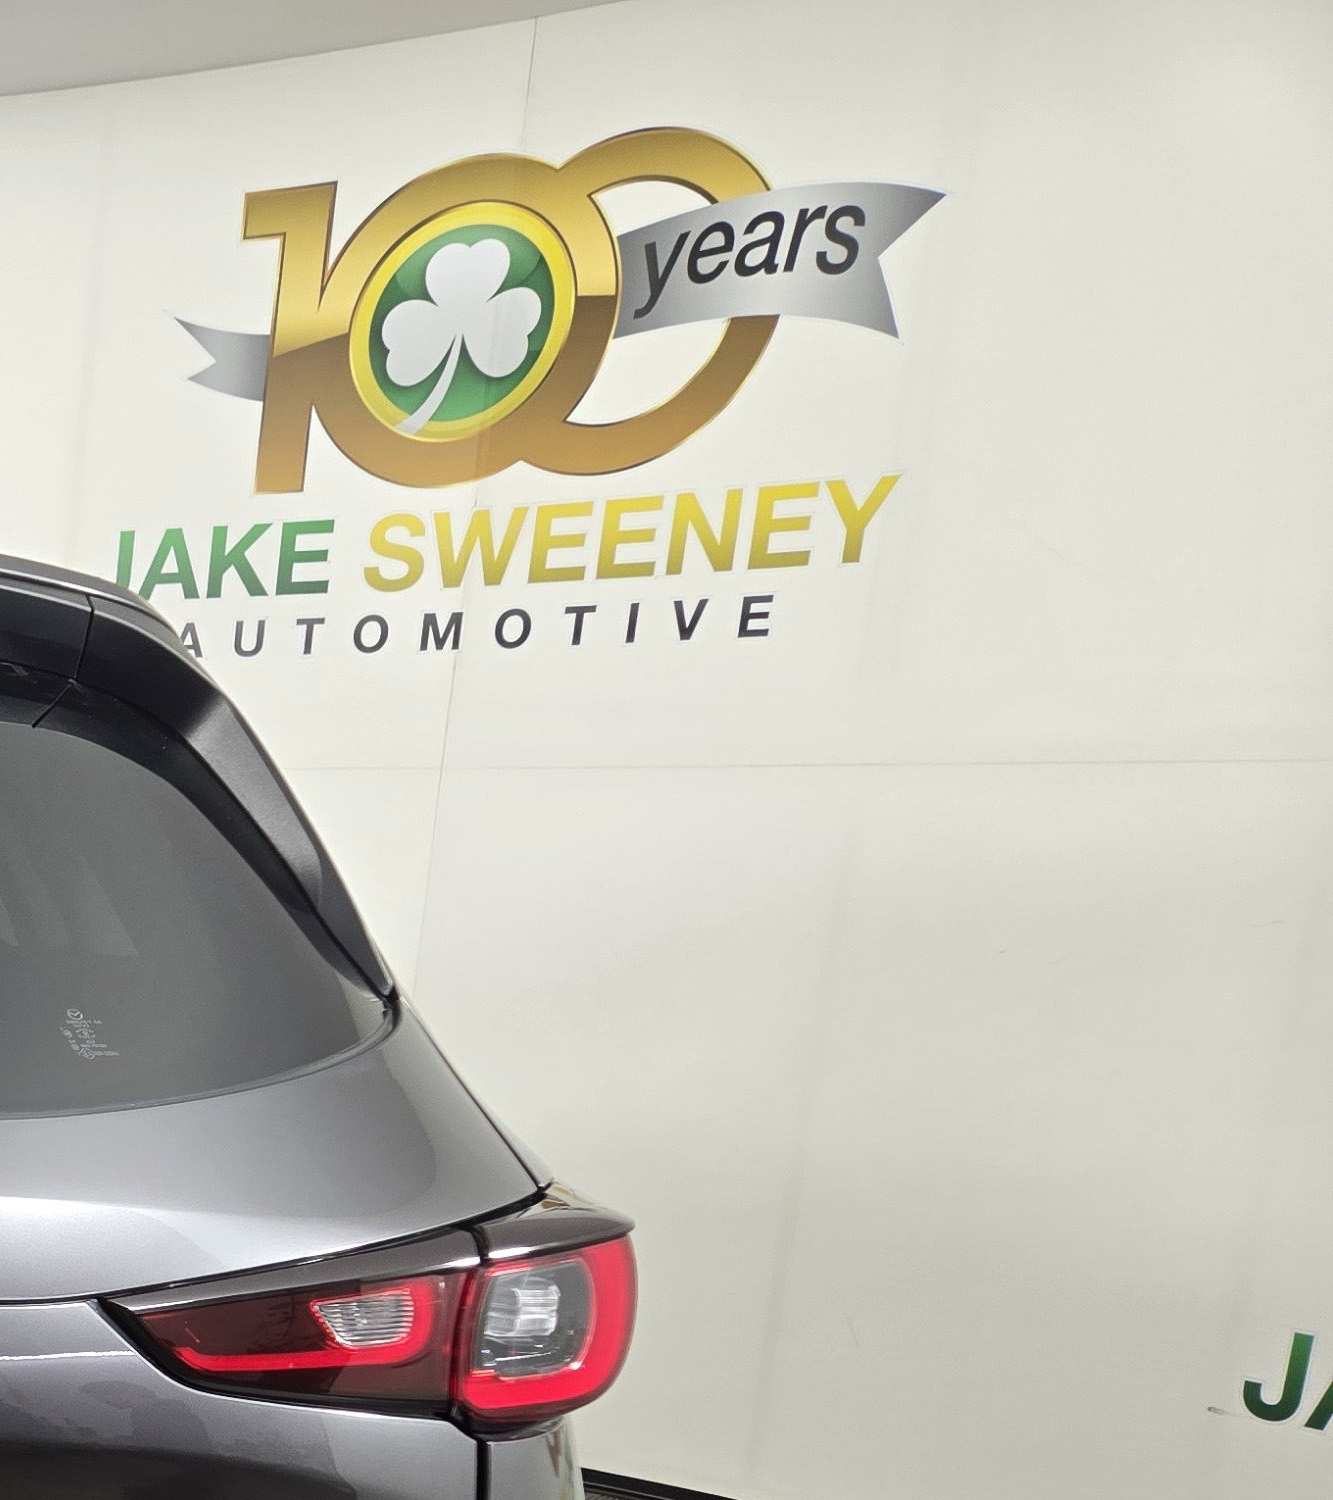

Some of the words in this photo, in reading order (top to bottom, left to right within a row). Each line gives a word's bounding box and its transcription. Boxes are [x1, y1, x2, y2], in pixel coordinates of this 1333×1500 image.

[632, 204, 866, 320] years
[363, 474, 902, 593] SWEENEY
[180, 595, 775, 658] AUTOMOTIVE
